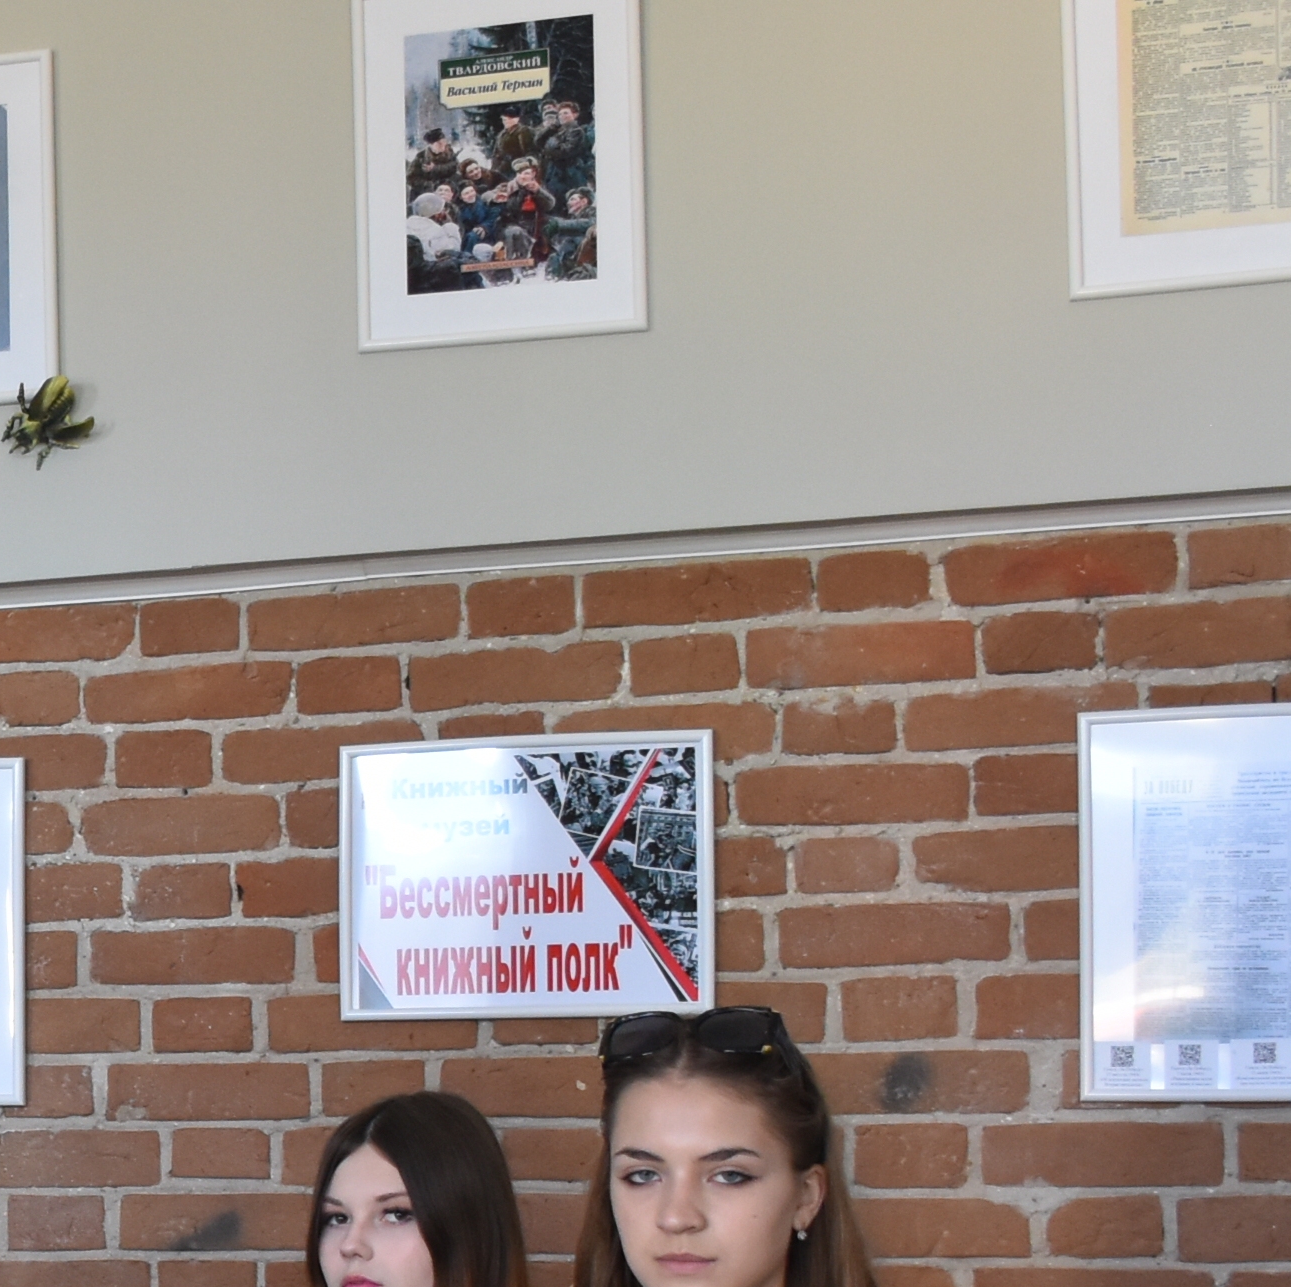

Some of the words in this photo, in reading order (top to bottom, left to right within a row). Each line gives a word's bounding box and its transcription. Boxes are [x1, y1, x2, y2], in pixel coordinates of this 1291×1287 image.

[447, 56, 541, 76] ТВАРДОВСКИЙ
[446, 81, 498, 97] Василий
[501, 78, 544, 93] Теркин
[391, 772, 528, 799] Книжный
[365, 856, 584, 930] "Бессмертный
[396, 925, 536, 996] книжный
[546, 924, 633, 993] полк"
